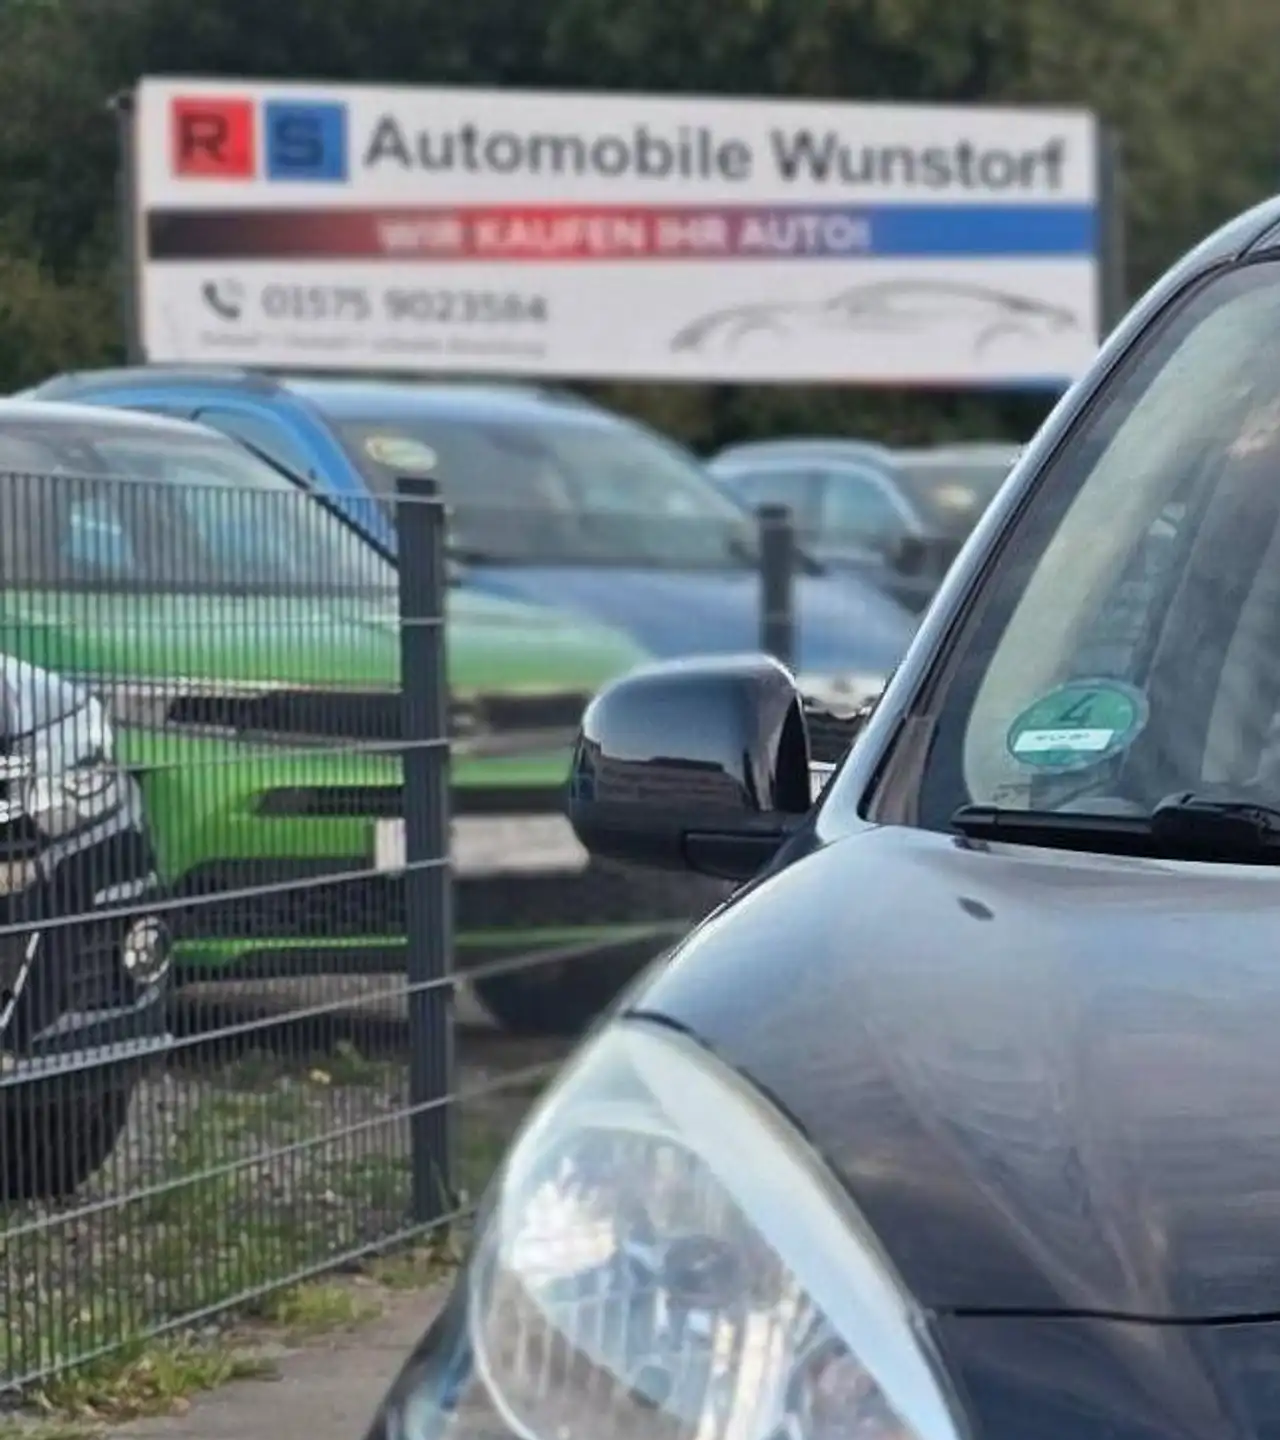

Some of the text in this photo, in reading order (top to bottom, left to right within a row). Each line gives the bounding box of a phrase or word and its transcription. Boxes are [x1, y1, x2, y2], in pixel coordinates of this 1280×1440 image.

[180, 112, 1067, 190] R S Automobile Wunstorf
[378, 217, 463, 250] WIR
[473, 216, 646, 250] KAUFEN
[655, 217, 727, 249] IHR
[1059, 691, 1098, 727] 4
